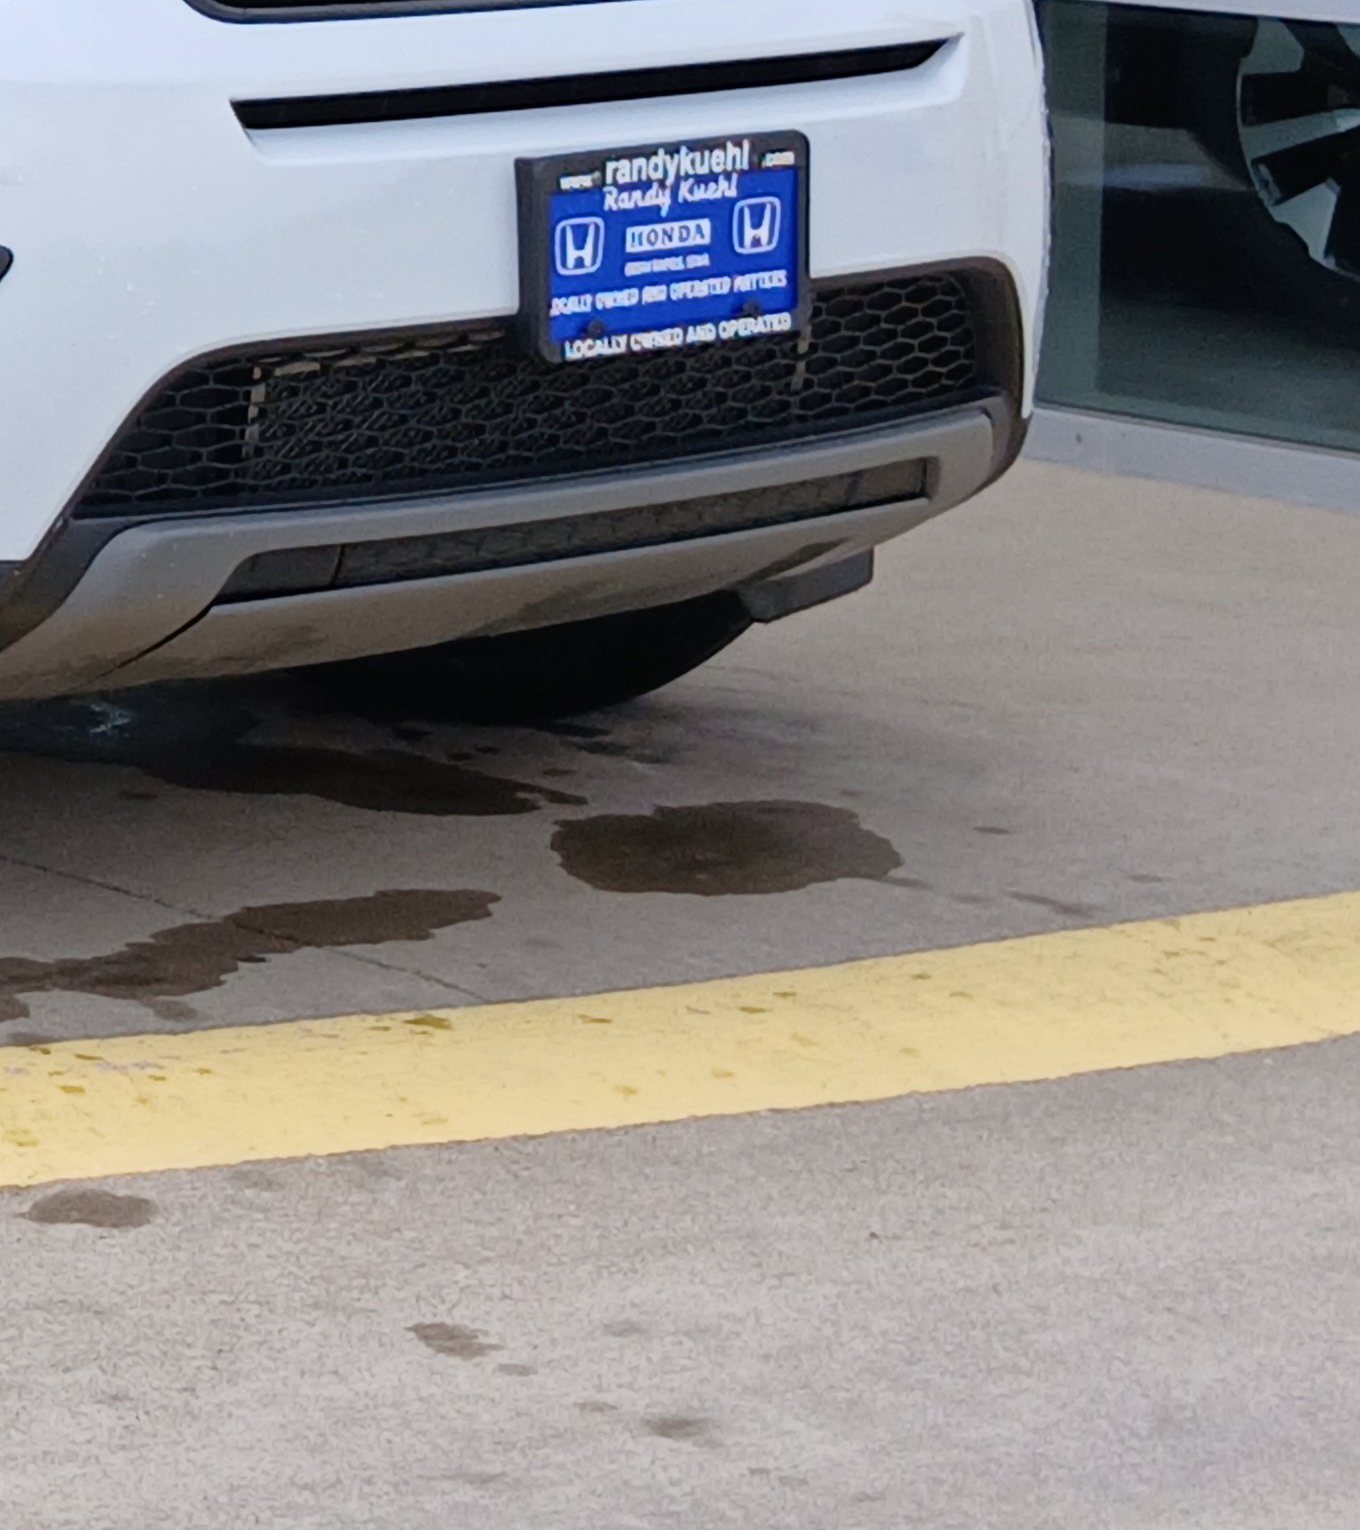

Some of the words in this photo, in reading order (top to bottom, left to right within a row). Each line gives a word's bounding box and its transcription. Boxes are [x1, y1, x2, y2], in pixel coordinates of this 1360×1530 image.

[605, 139, 750, 187] randykuehl
[603, 183, 672, 217] Randy
[678, 173, 738, 203] Kuehl
[630, 223, 705, 248] HONDA
